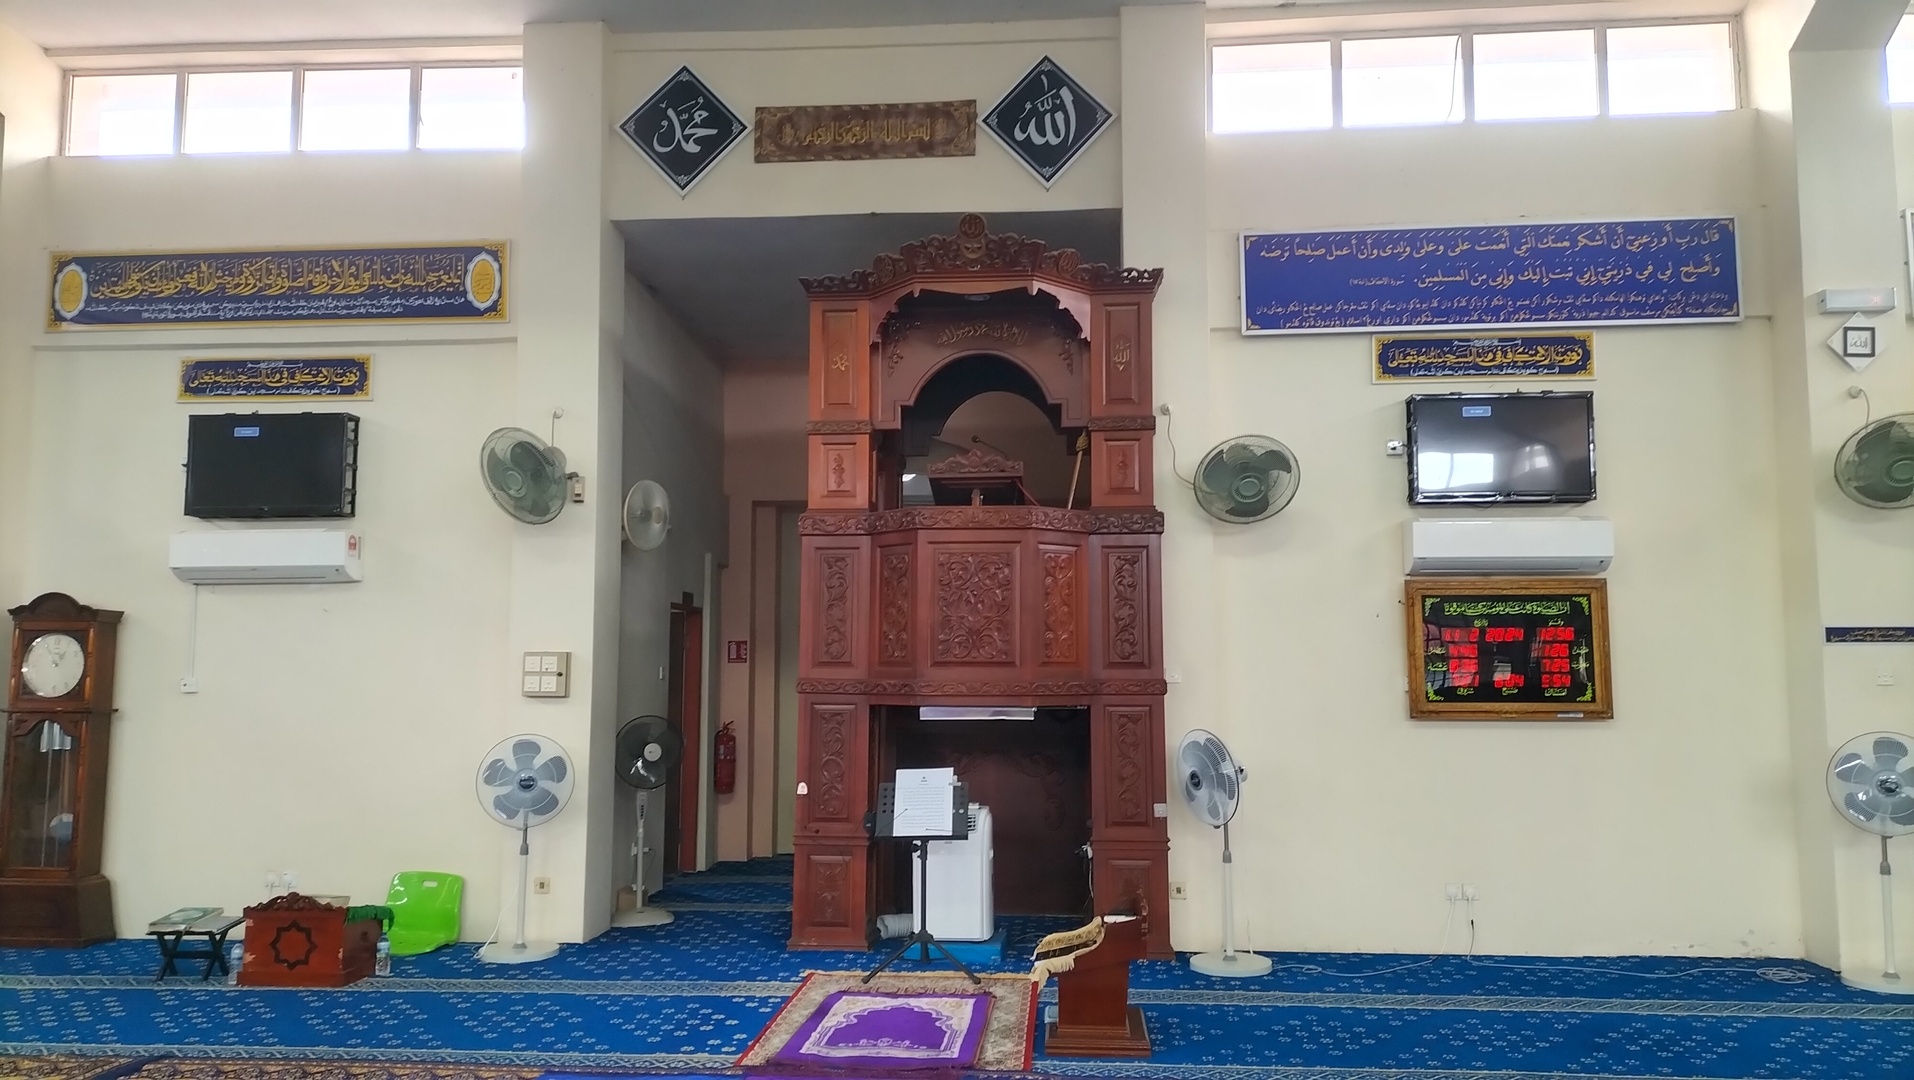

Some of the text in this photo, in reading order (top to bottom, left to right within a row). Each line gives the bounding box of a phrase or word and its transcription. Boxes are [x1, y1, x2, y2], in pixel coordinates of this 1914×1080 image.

[1014, 74, 1077, 146] الله
[653, 96, 718, 153] محمد
[1700, 222, 1720, 244] قال
[1469, 628, 1479, 642] 2
[1485, 628, 1524, 642] 2024
